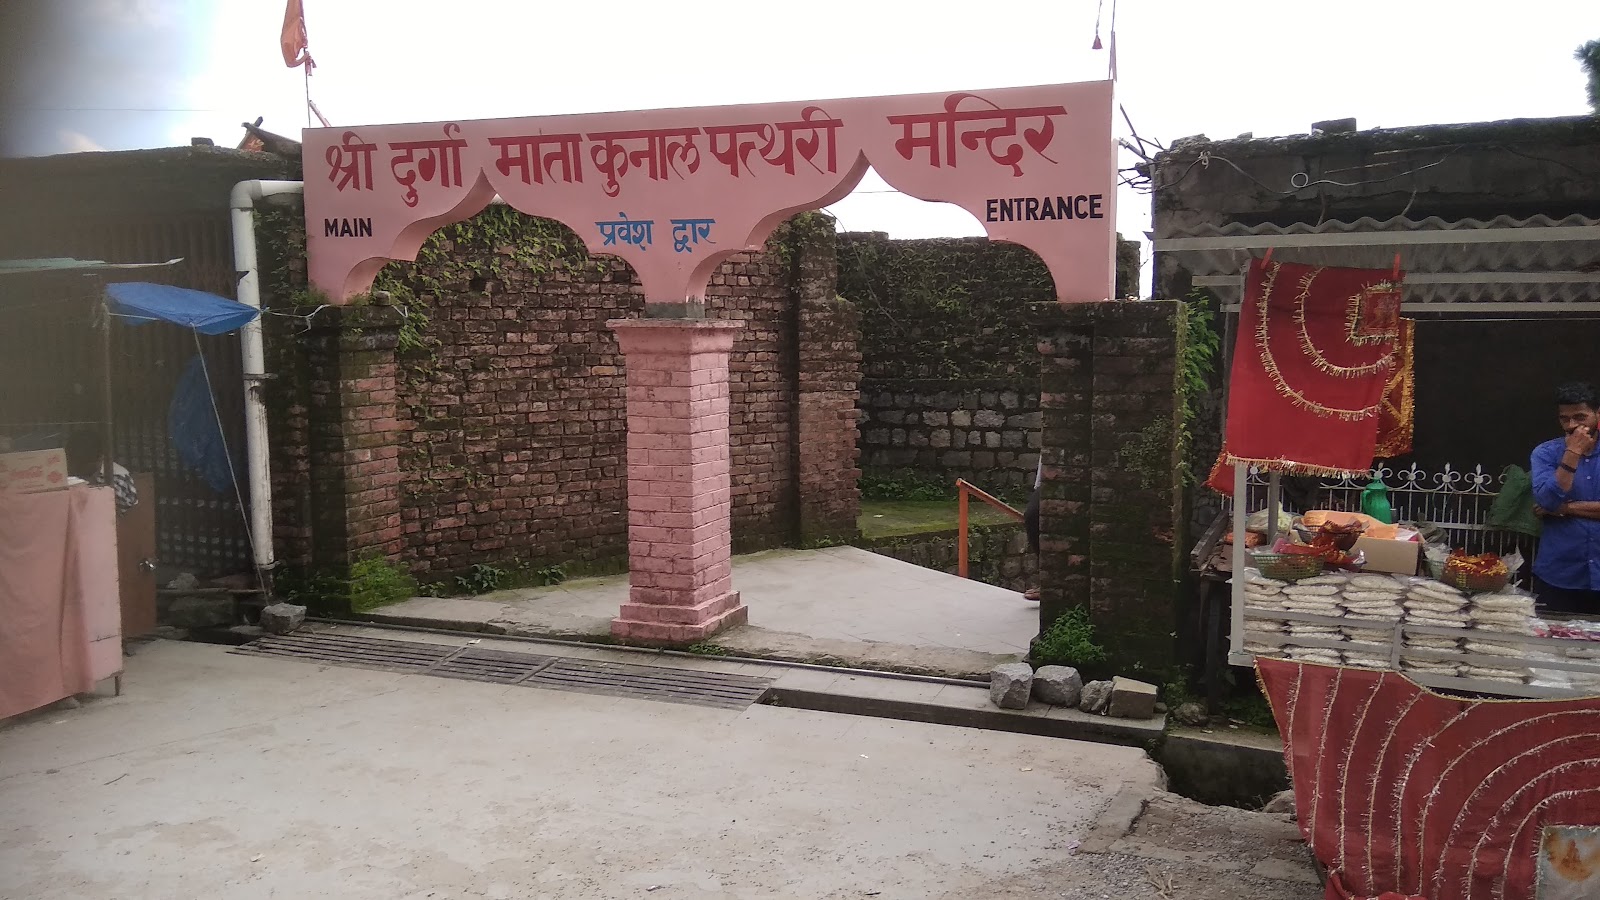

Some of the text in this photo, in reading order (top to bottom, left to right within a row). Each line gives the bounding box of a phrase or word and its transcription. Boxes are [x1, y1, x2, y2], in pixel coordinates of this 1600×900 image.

[325, 131, 377, 192] श्री
[388, 123, 468, 208] दुर्गा
[488, 132, 584, 184] माता
[586, 127, 702, 198] कुनाल
[887, 93, 1068, 177] मन्दिर
[986, 194, 1104, 222] ENTRANCE
[324, 217, 373, 238] MAIN
[595, 211, 717, 253] प्रवेश द्वार
